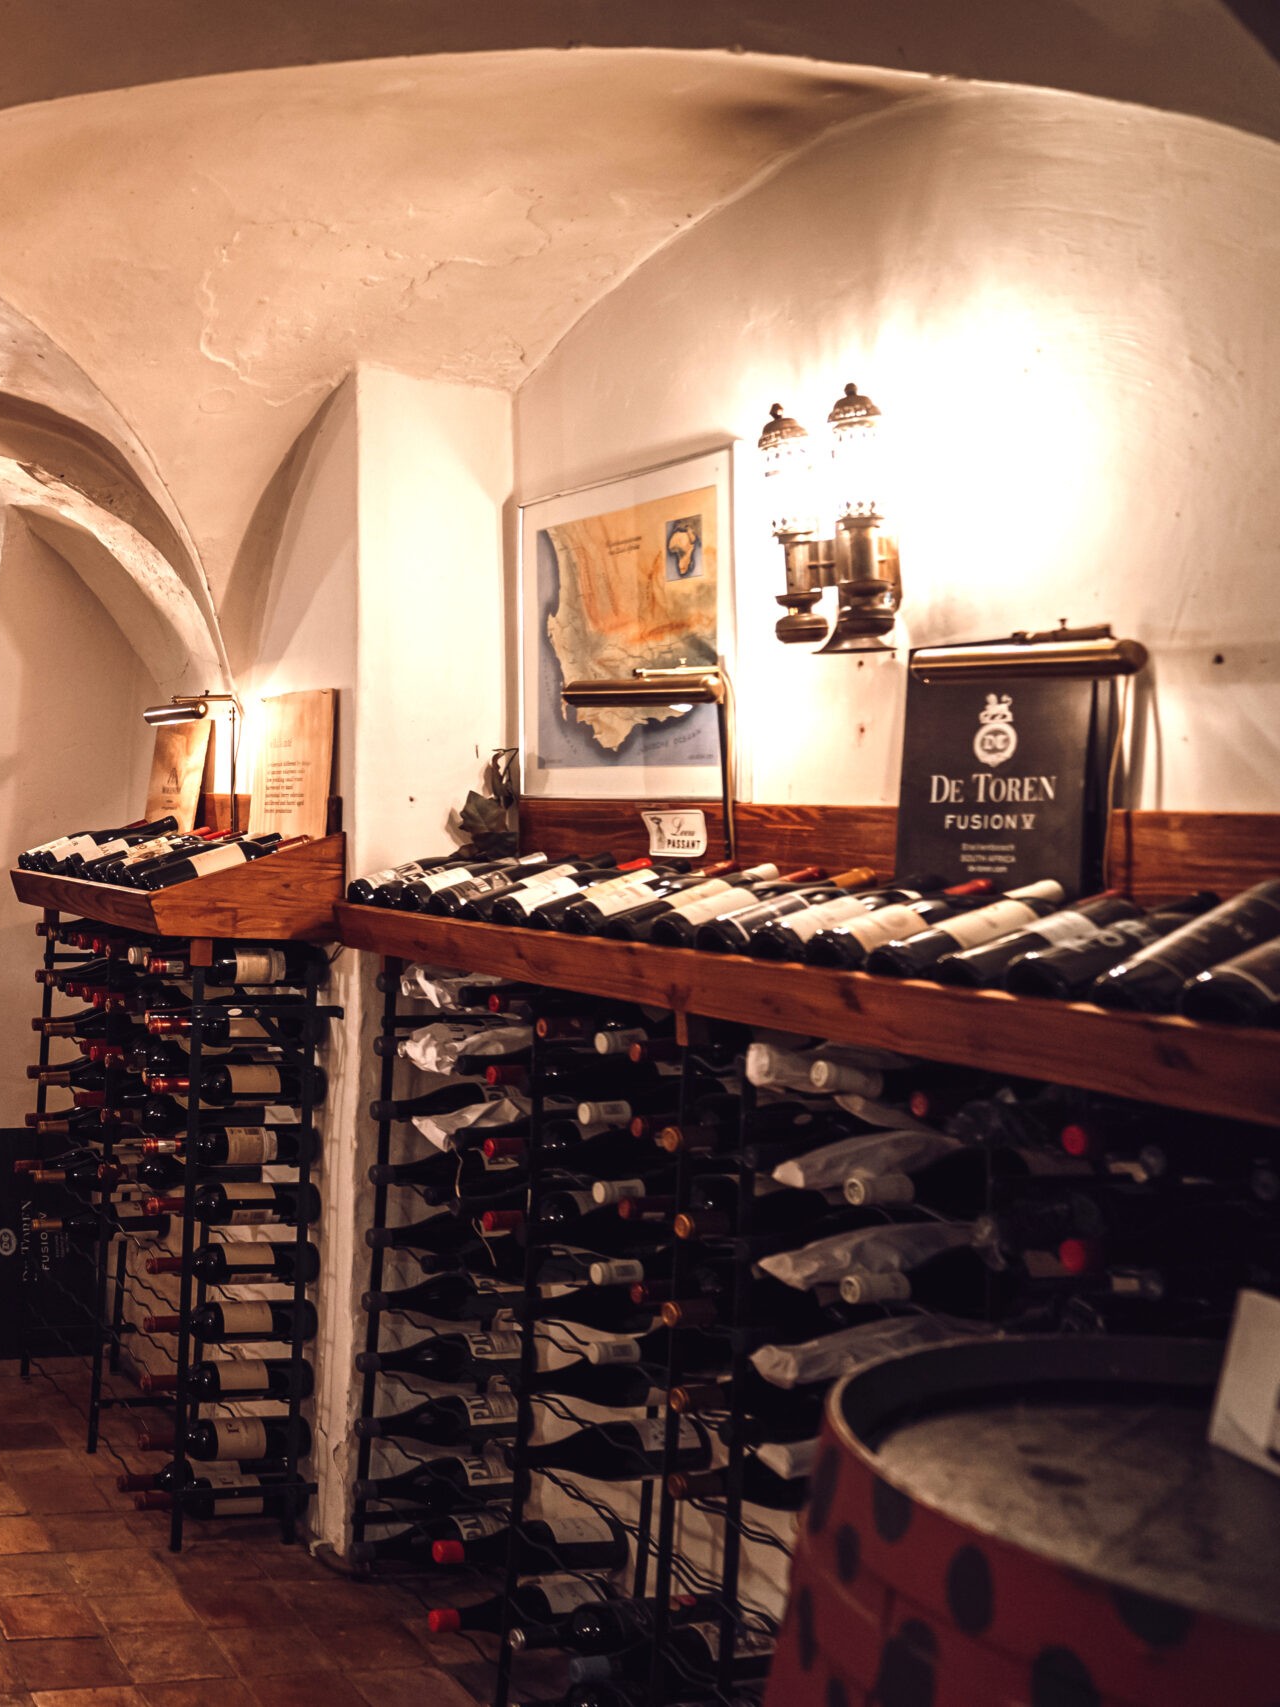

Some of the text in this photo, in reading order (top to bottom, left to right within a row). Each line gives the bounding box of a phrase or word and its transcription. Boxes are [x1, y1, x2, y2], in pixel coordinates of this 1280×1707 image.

[929, 772, 1057, 803] DE TOREN
[944, 813, 1036, 830] FUSION V
[667, 839, 701, 850] PASSANT
